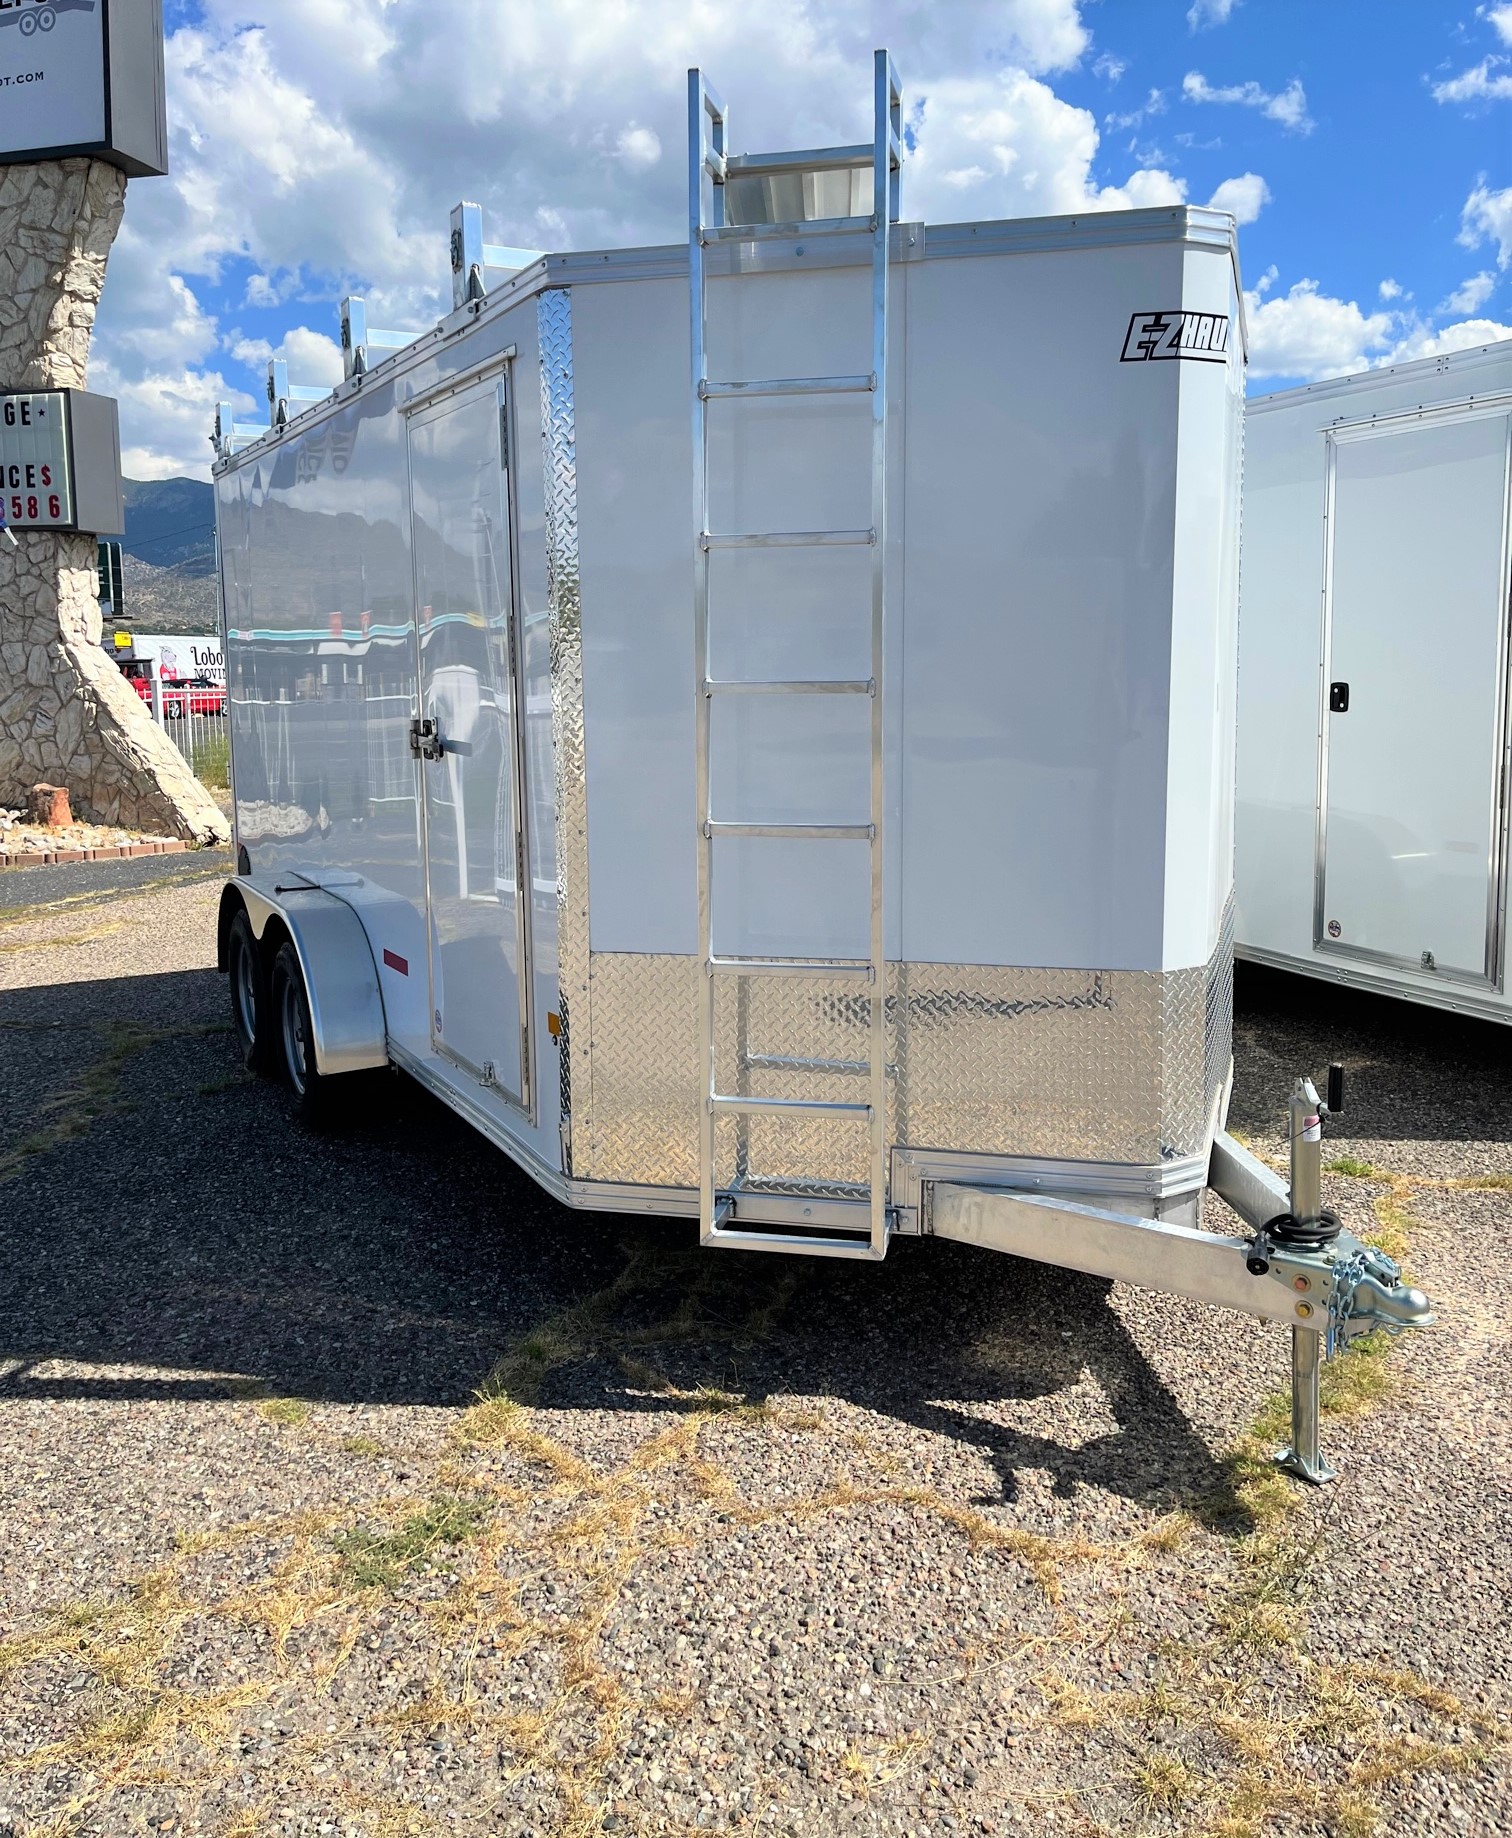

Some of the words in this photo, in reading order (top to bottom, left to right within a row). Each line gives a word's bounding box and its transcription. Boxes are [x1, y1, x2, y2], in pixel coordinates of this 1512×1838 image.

[1180, 313, 1228, 352] HAU
[4, 401, 31, 426] GE
[190, 646, 223, 666] Lobo
